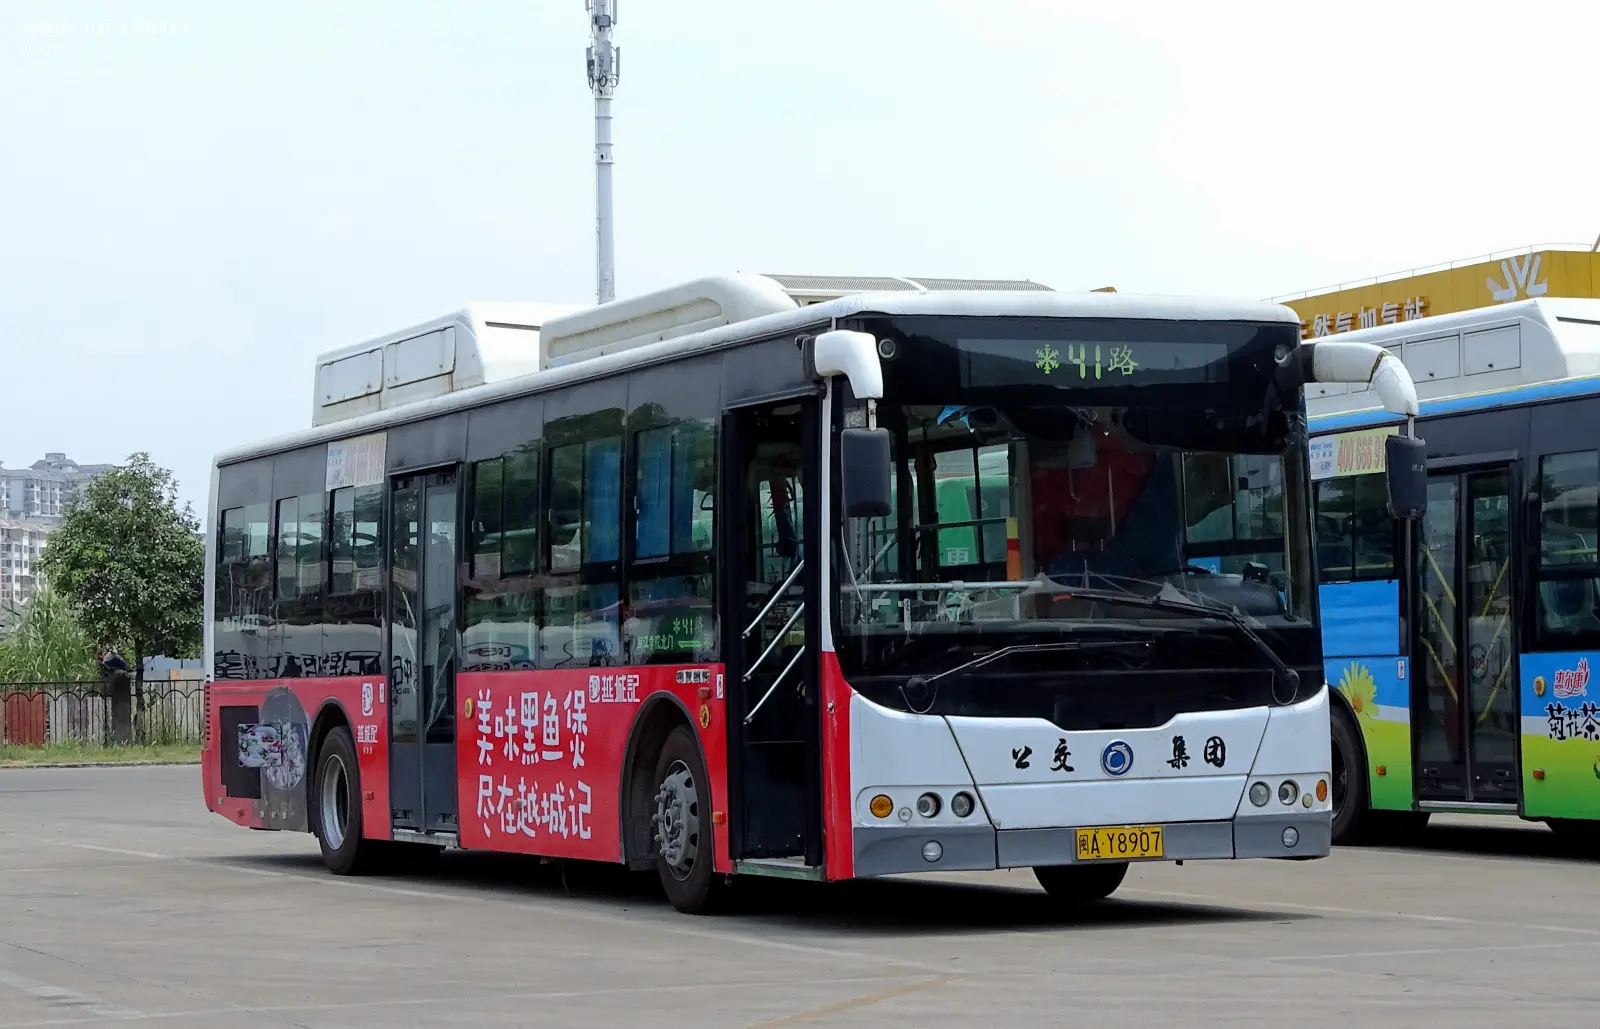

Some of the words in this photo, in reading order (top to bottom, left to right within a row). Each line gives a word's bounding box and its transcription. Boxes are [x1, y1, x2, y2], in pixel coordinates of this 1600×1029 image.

[1068, 343, 1140, 380] 41路
[476, 688, 588, 769] 美味黑鱼煲
[1545, 702, 1600, 742] 菊花茶
[476, 774, 592, 840] 尽在越城记
